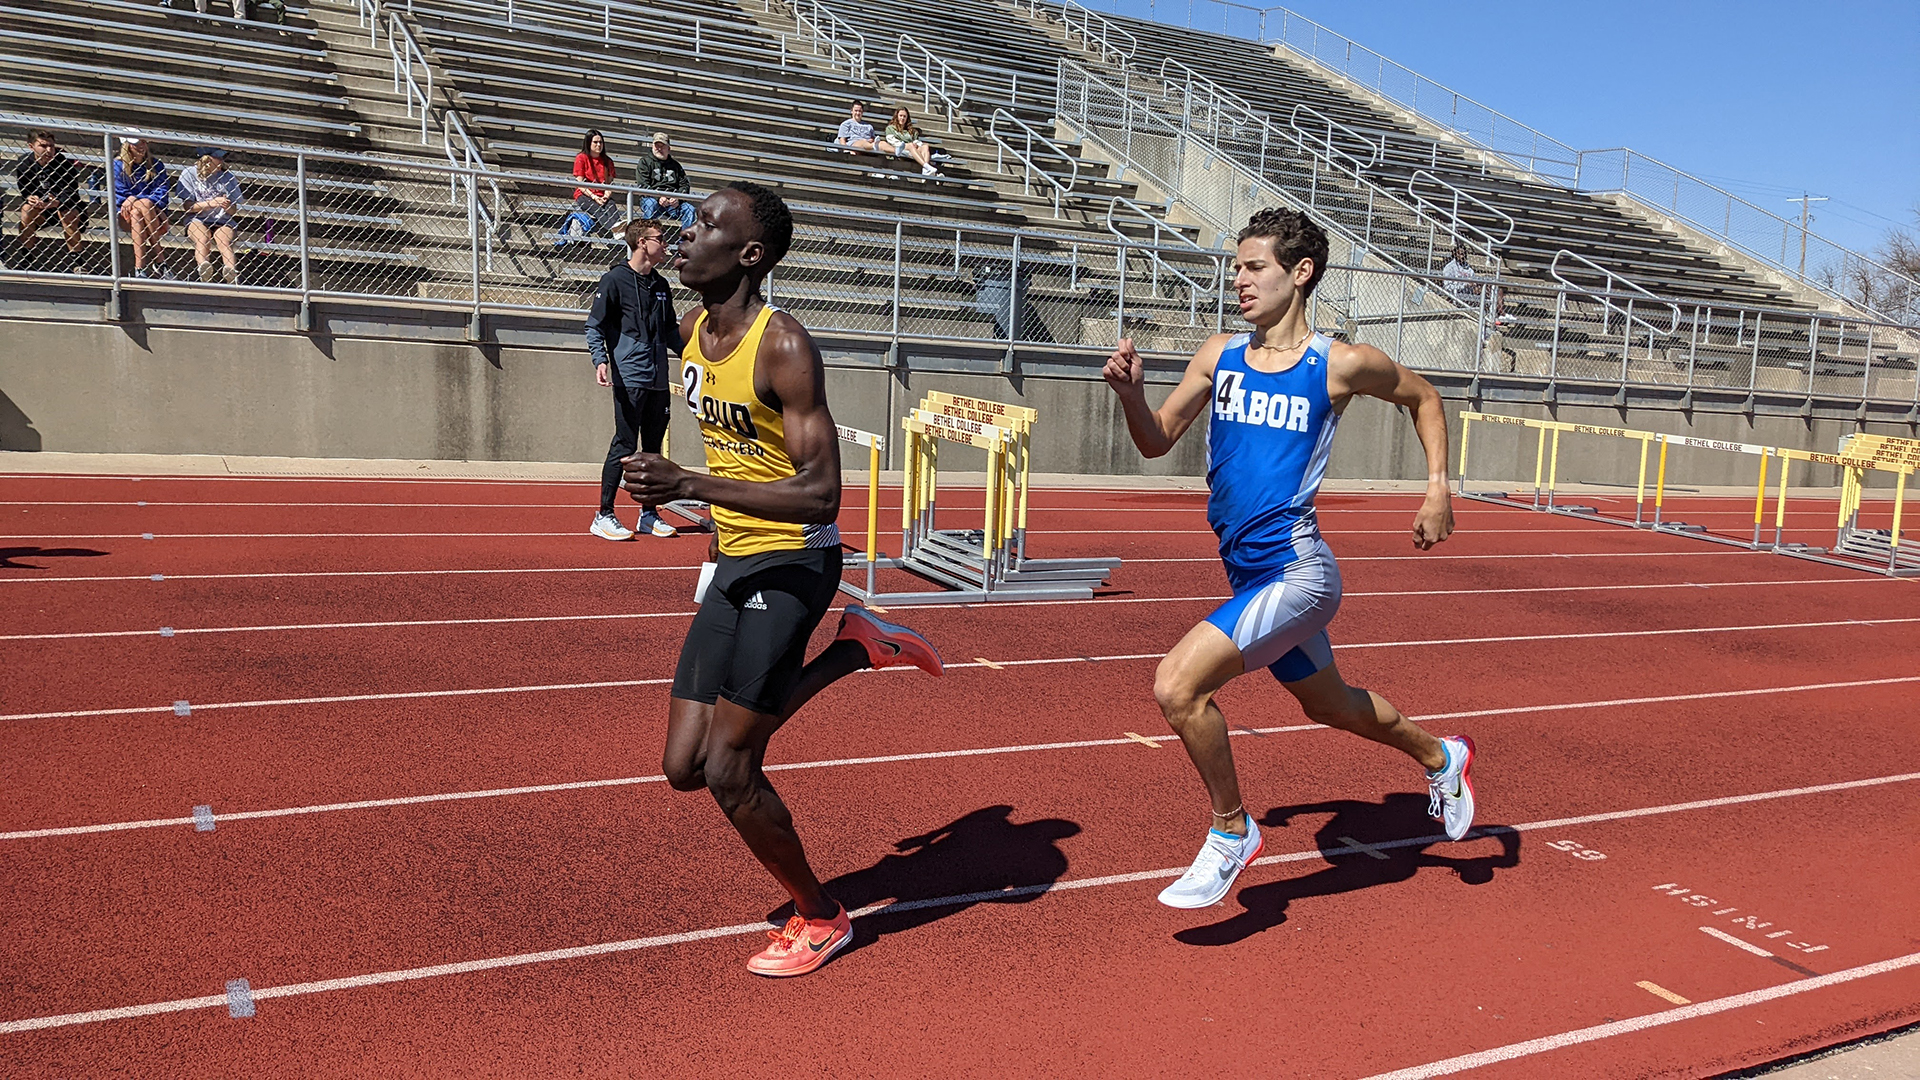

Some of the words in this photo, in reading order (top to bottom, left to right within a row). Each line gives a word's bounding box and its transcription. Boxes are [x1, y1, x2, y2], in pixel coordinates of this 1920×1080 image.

[684, 365, 698, 410] 2
[1217, 374, 1236, 411] 4
[943, 405, 965, 419] BETHEL
[967, 410, 994, 425] COLLEGE
[952, 396, 975, 409] BETHEL
[977, 401, 1005, 415] COLLEGE
[701, 395, 759, 440] OUD
[933, 414, 955, 428] BETHEL
[956, 419, 982, 435] COLLEGE
[1481, 414, 1501, 423] BETHEL
[1502, 417, 1526, 426] COLLEGE
[836, 426, 857, 443] OLLEGE
[924, 424, 945, 439] BETHEL
[947, 429, 973, 445] COLLEGE
[1574, 425, 1596, 434] BETHEL
[1598, 428, 1626, 437] COLLEGE
[1685, 438, 1710, 448] BETHEL
[1712, 442, 1743, 452] COLLEGE
[1810, 453, 1839, 464] BETHEL
[1841, 457, 1877, 469] COLLEGE
[1652, 882, 1830, 955] FINISH
